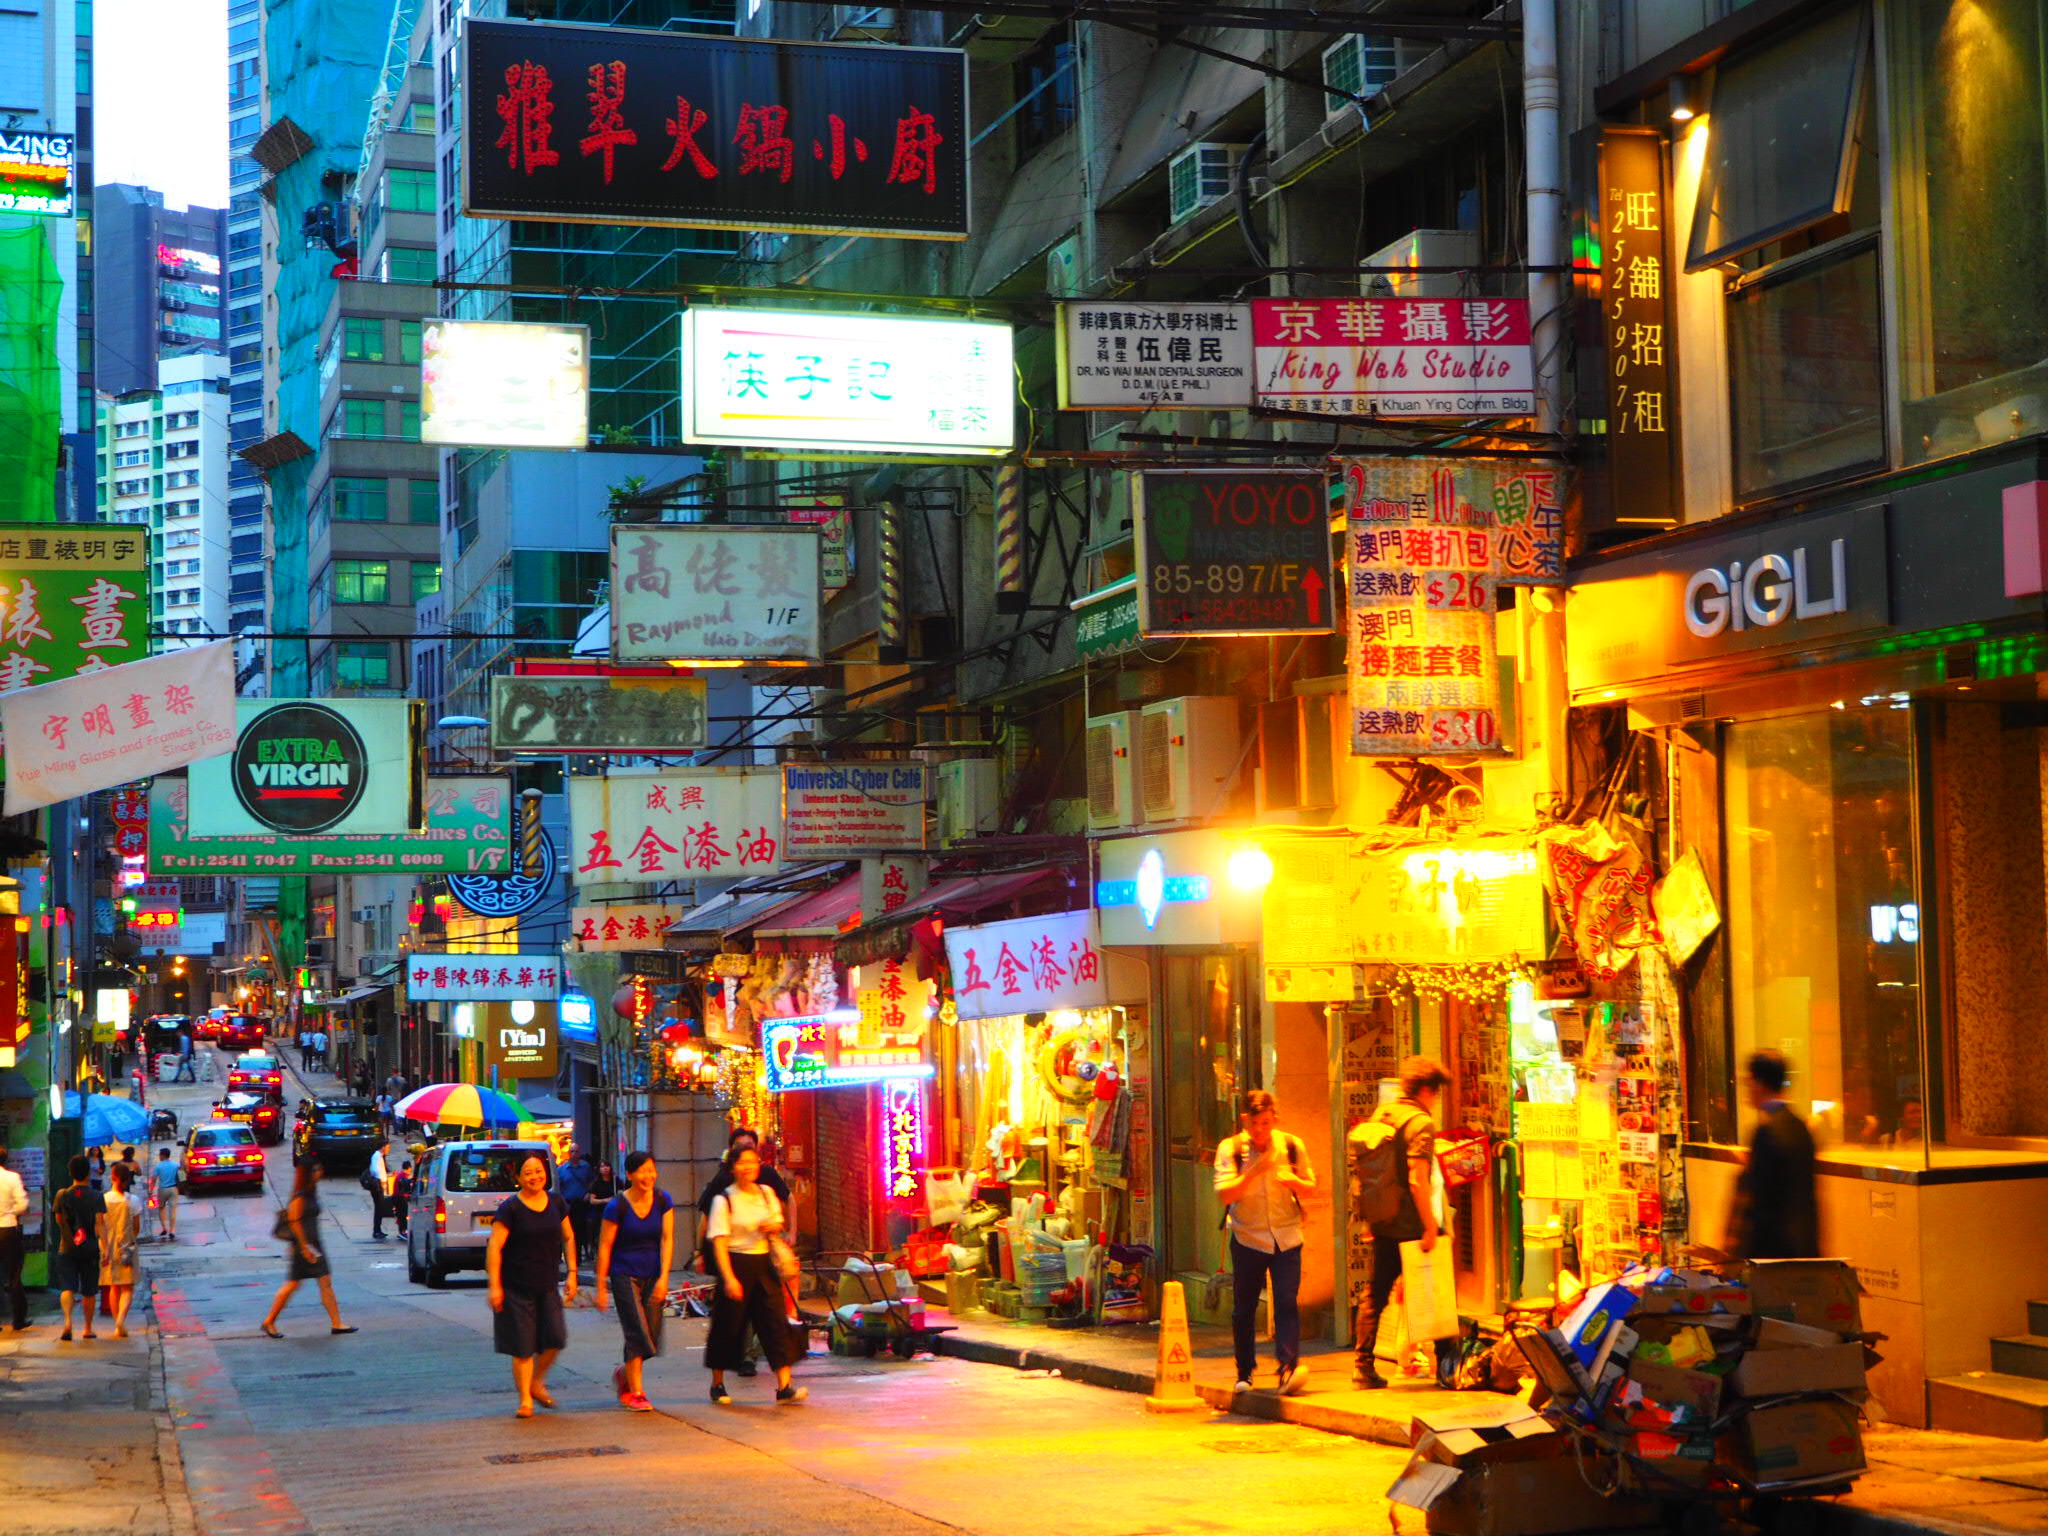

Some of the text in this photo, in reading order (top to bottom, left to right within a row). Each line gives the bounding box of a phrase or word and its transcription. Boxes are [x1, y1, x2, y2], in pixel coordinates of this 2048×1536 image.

[1079, 312, 1238, 331] 菲律賓東方大學牙科博士
[1271, 301, 1511, 342] 京華攝影
[1136, 337, 1222, 363] 伍偉民
[722, 350, 893, 400] 筷子記
[1096, 366, 1110, 377] NG
[1113, 366, 1131, 377] WAI
[1133, 366, 1156, 377] MAN
[1279, 348, 1511, 390] King Wah Studio
[1382, 399, 1420, 412] Khuan
[1425, 398, 1452, 413] Ying
[1502, 396, 1528, 412] Bldg
[1202, 484, 1316, 526] YOYO
[1411, 493, 1429, 519] 至
[1154, 563, 1299, 594] 85-89 7/F
[1427, 569, 1487, 608] $26
[626, 600, 735, 646] Raymond
[767, 607, 801, 627] 1/F
[1357, 609, 1414, 644] 澳門
[42, 684, 196, 751] 宇明畫架
[1359, 710, 1425, 735] 送熱飲
[1432, 711, 1495, 746] $30
[44, 758, 77, 775] Ming
[146, 725, 194, 746] Frames
[196, 719, 218, 732] Co.
[161, 728, 233, 758] Since 1983
[257, 738, 344, 763] EXTRA
[248, 763, 350, 787] VIRGIN
[788, 767, 921, 791] Universal Cyber Café
[473, 823, 506, 841] Co.
[578, 820, 777, 874] 五金漆油
[254, 853, 297, 867] 7047
[400, 853, 445, 866] 6008
[959, 935, 1099, 997] 五金漆油
